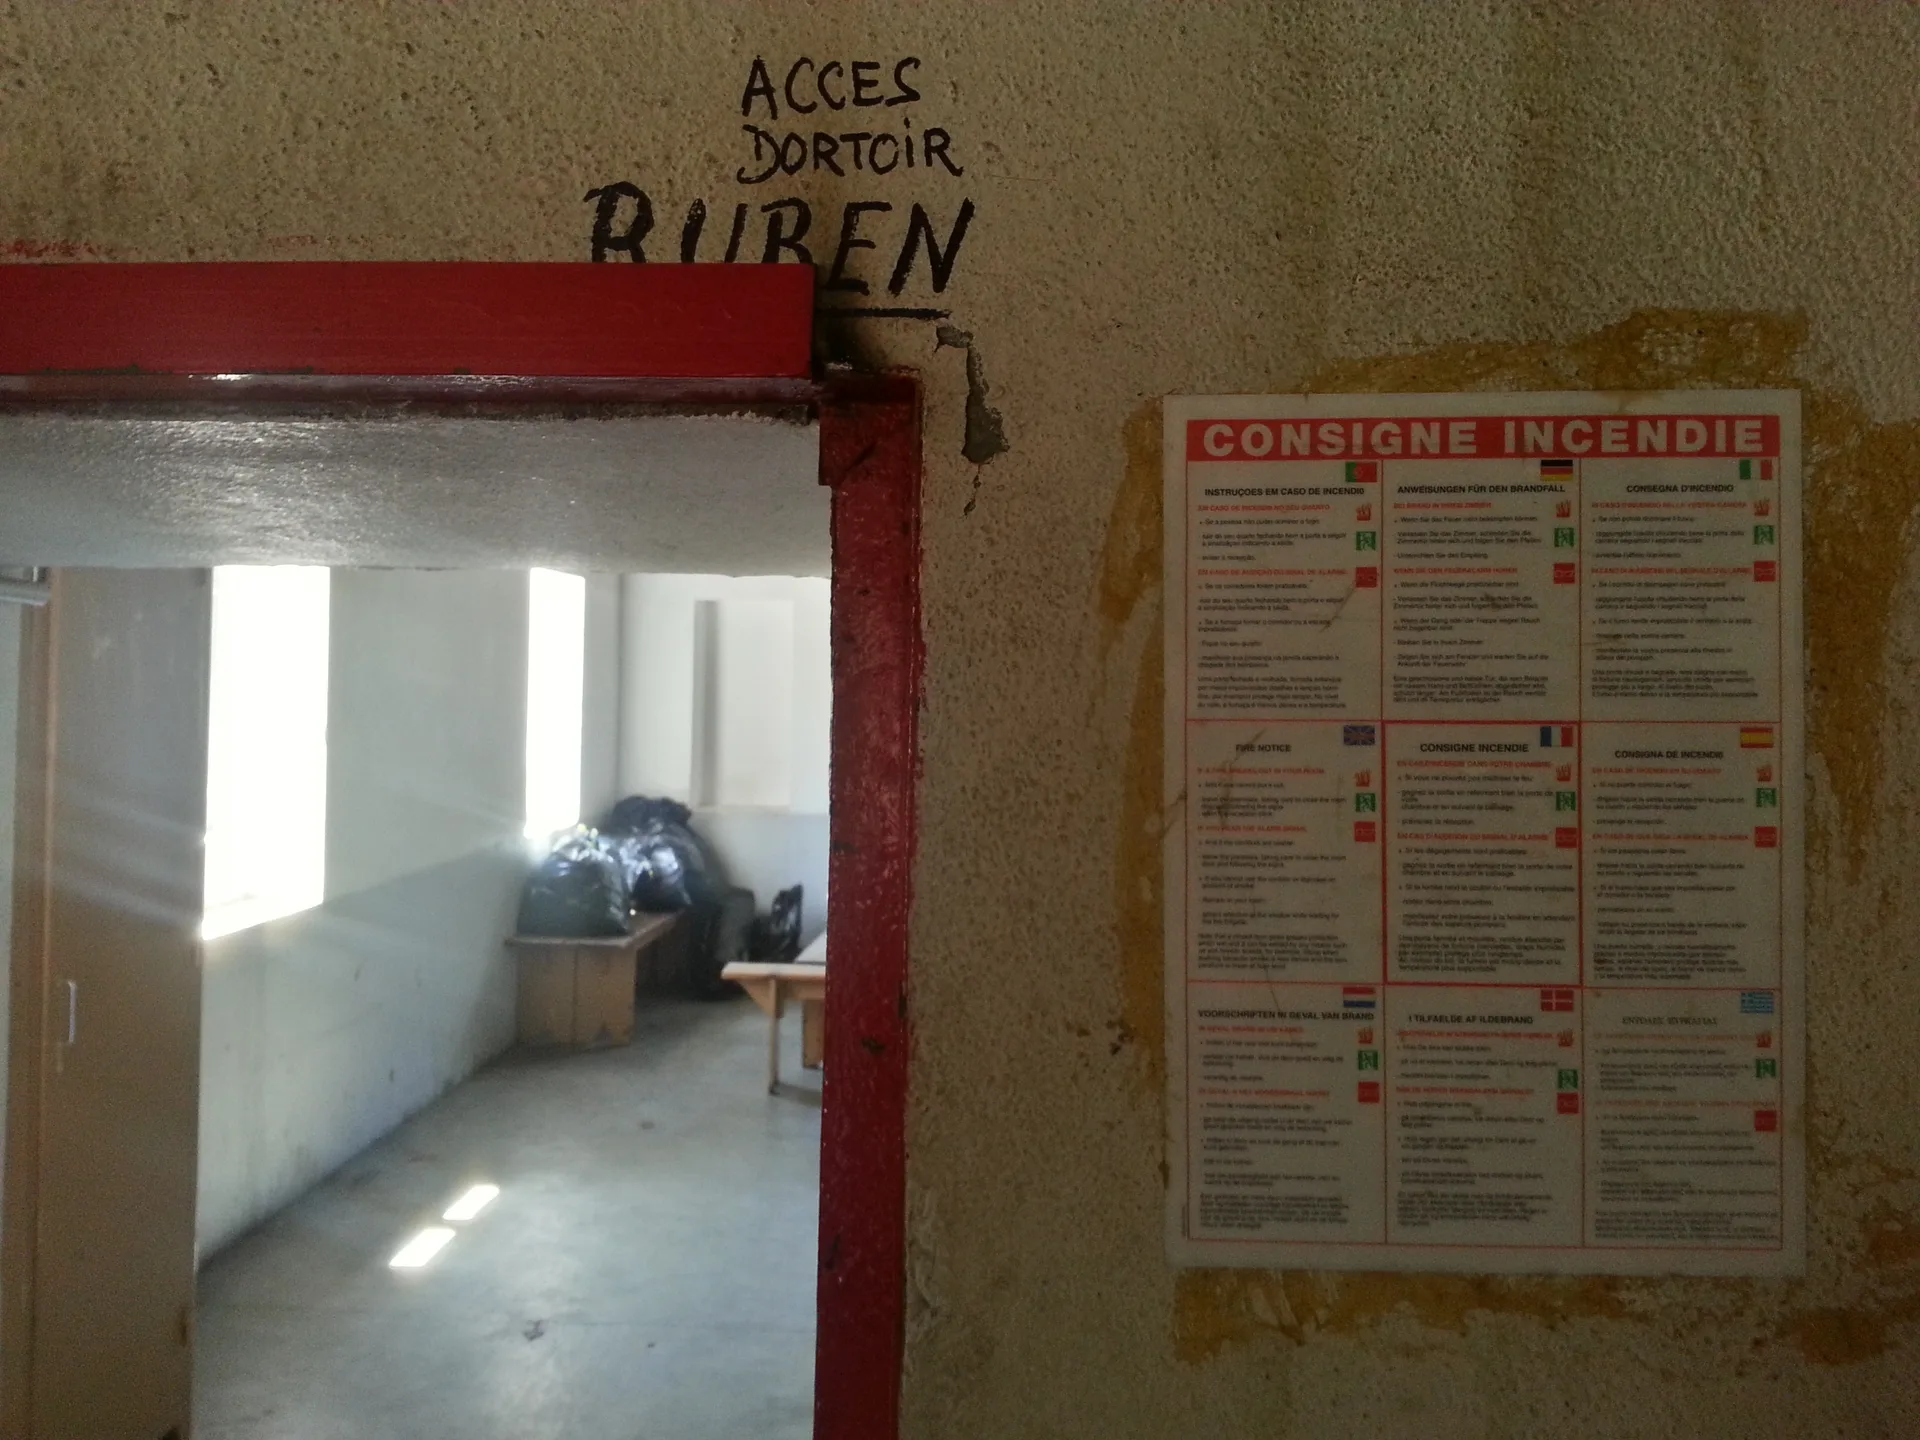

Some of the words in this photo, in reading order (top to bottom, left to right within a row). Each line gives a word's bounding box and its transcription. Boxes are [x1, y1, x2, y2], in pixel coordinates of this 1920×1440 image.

[741, 54, 921, 120] ACCES
[1202, 421, 1478, 458] CONSIGNE
[1503, 418, 1765, 455] INCENDIE
[1265, 487, 1279, 497] EM
[1280, 487, 1306, 497] CASO
[1308, 486, 1321, 496] DE
[1397, 485, 1466, 495] ANWEISUNGEN
[1467, 483, 1487, 494] FÜR
[1489, 485, 1509, 494] DEN
[1510, 484, 1566, 494] BRANDFALL
[1626, 484, 1679, 494] CONSEGNA
[1235, 743, 1256, 753] FIRE
[1258, 743, 1292, 753] NOTICE
[1419, 743, 1475, 753] CONSIGNE
[1478, 743, 1530, 753] INCENDIE
[1614, 750, 1664, 760] CONSIGNA
[1665, 750, 1678, 760] DE
